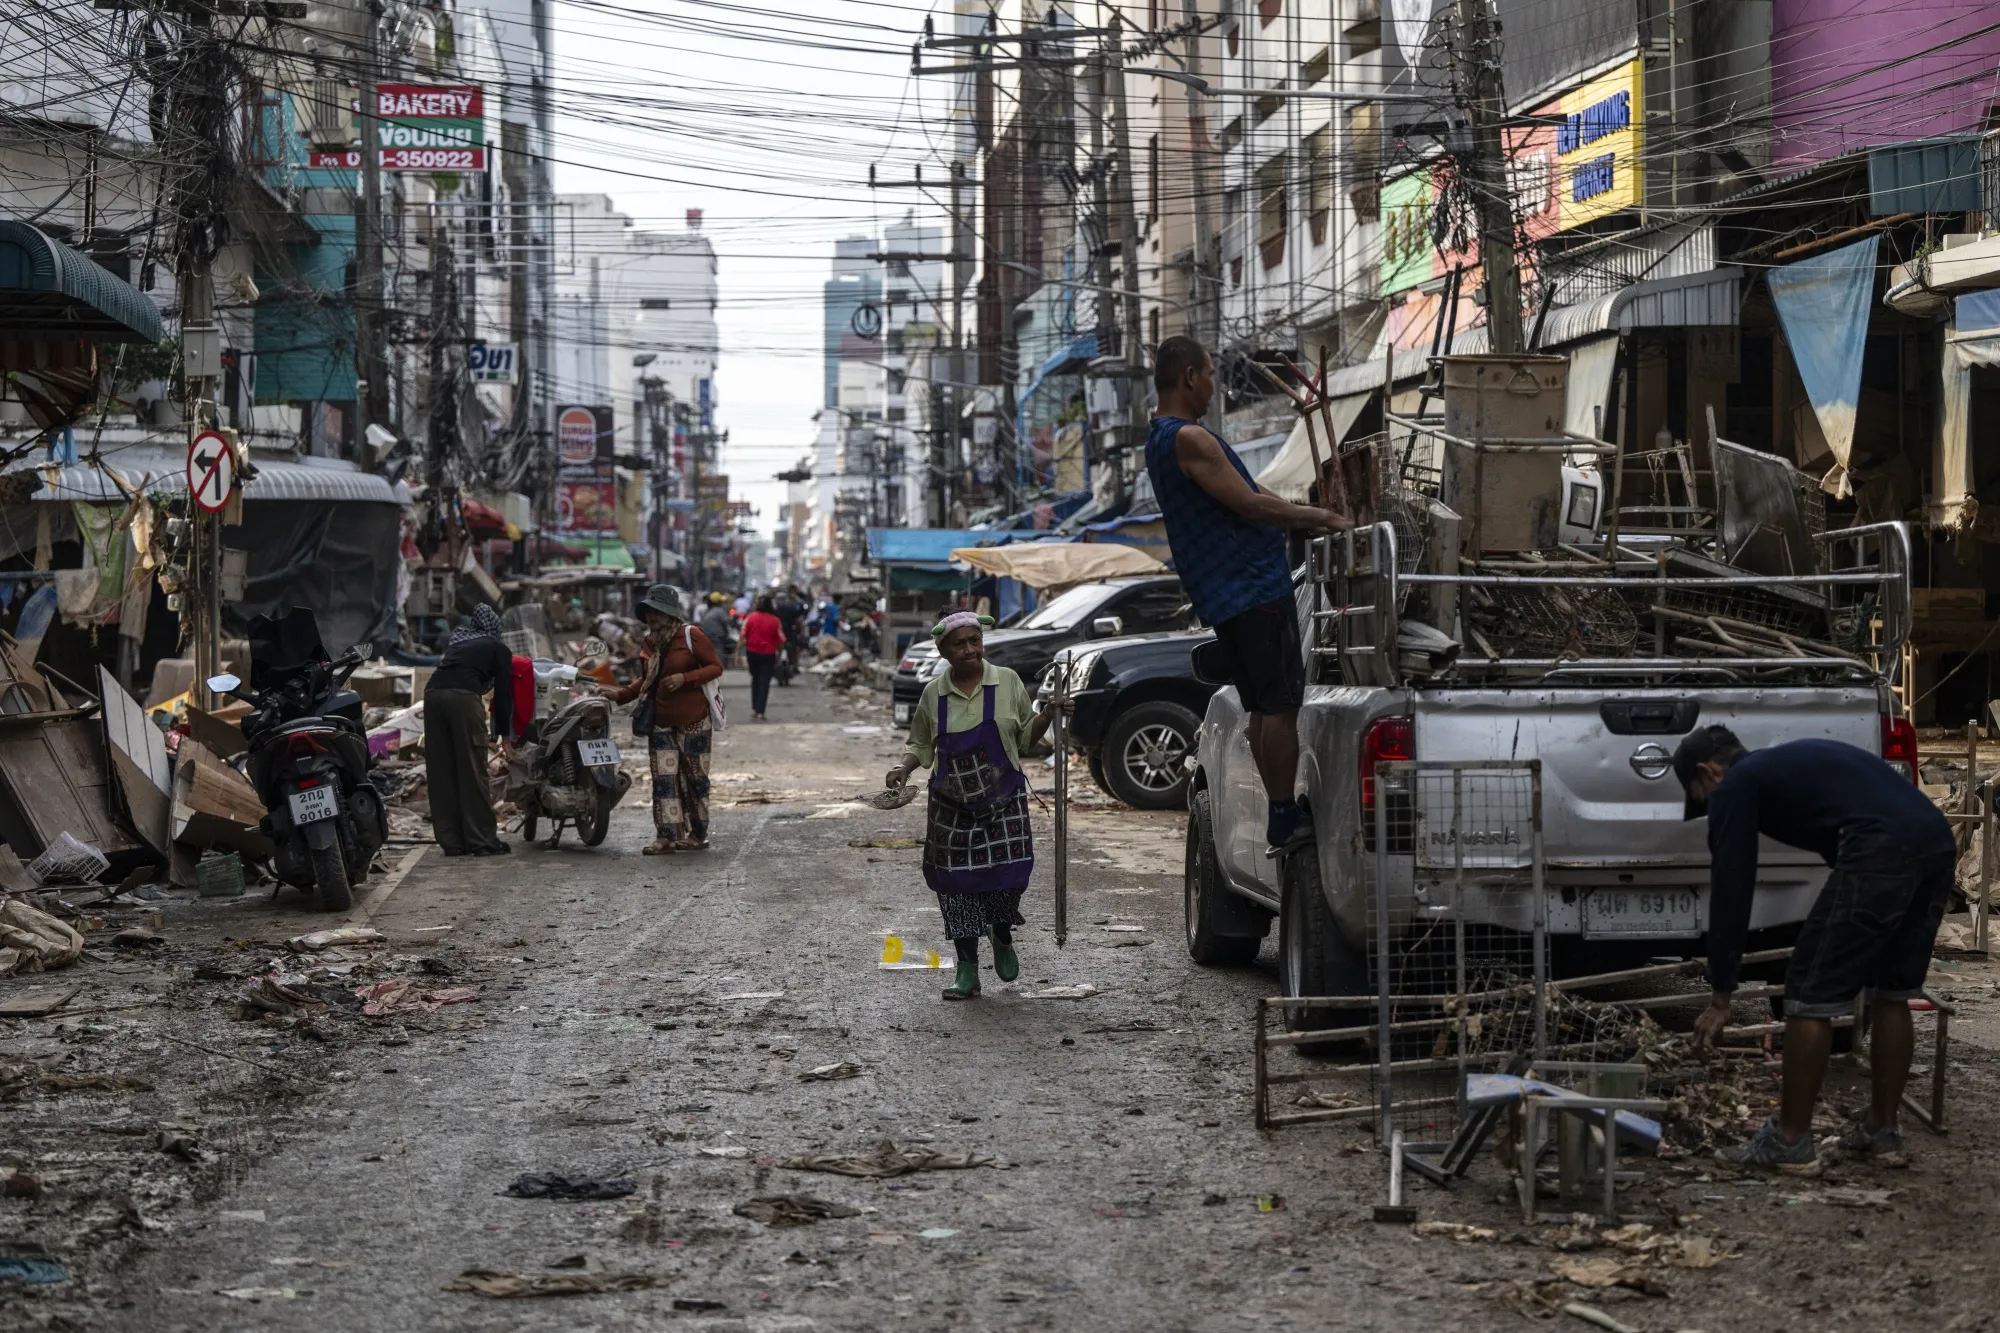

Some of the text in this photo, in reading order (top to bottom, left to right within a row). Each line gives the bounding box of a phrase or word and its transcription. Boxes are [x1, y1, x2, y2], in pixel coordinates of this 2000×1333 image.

[379, 93, 472, 115] BAKERY
[346, 151, 474, 167] 0-350922
[591, 755, 612, 763] 713
[300, 807, 332, 823] 9016
[1431, 831, 1521, 845] NAVARA
